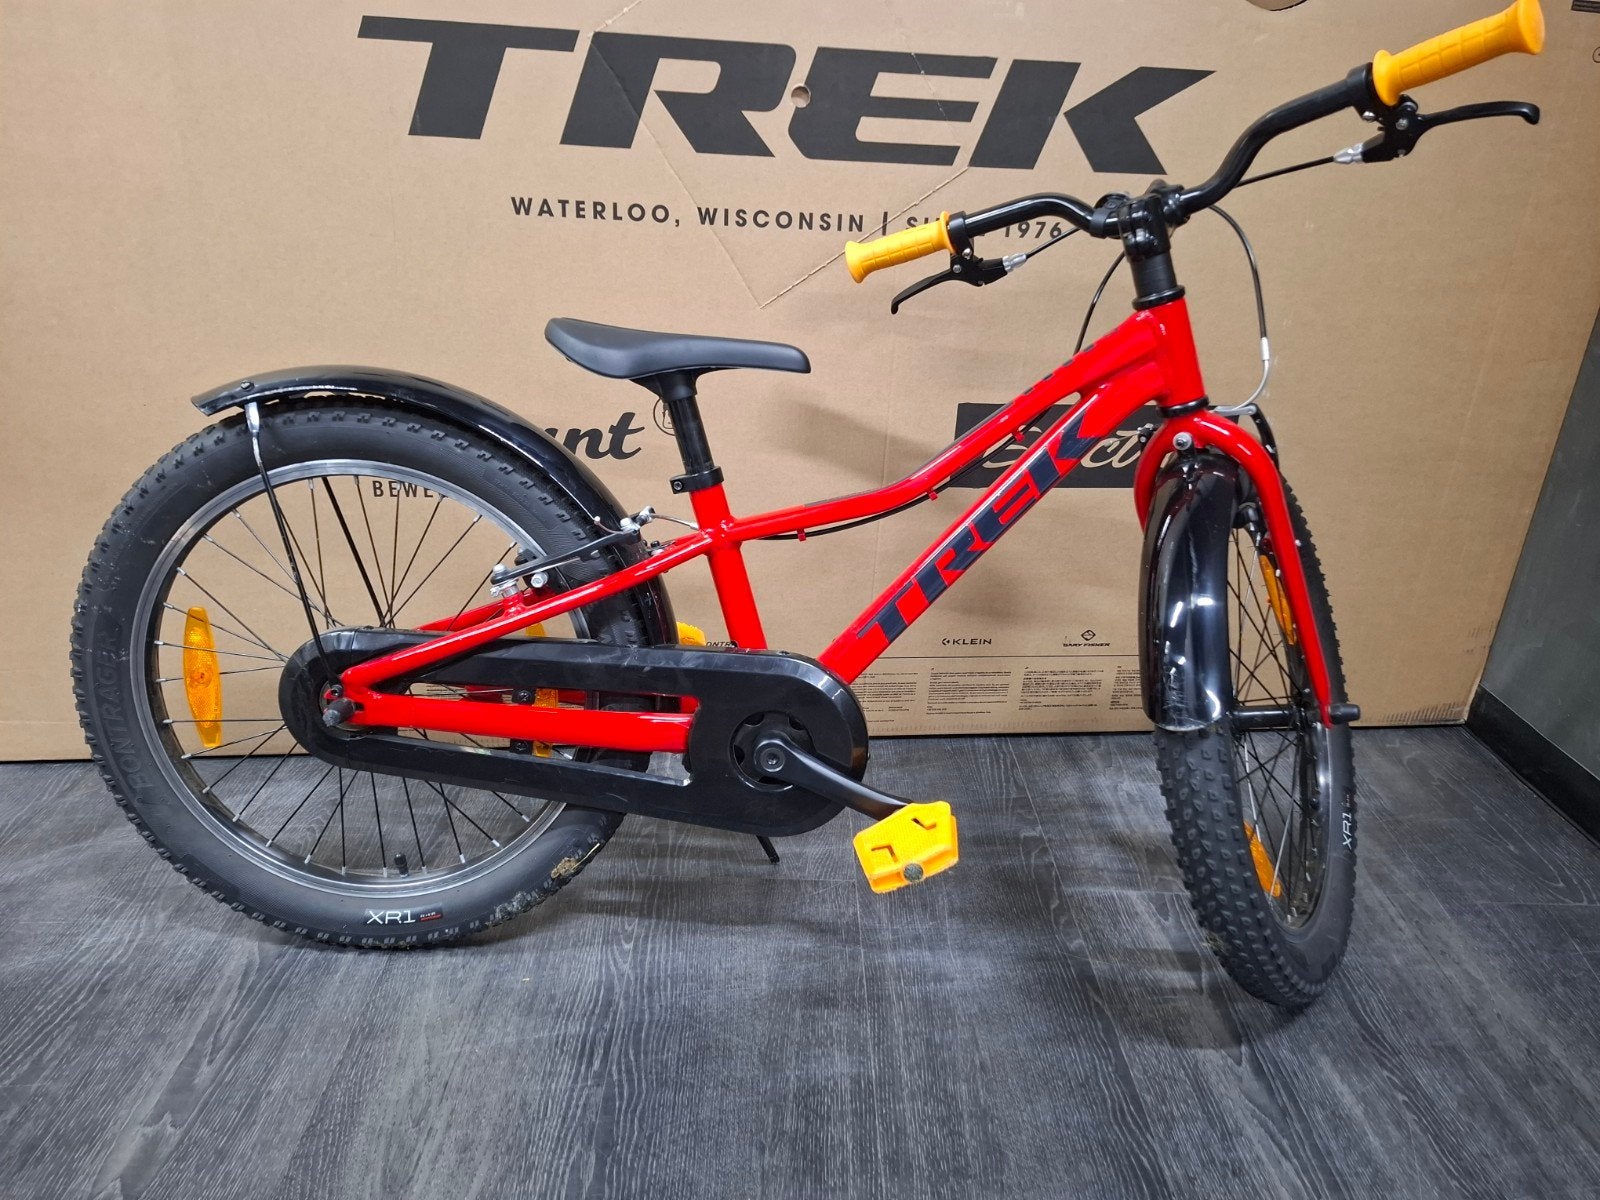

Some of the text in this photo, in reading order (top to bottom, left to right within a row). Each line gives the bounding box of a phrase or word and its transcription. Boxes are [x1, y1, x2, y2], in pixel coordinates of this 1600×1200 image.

[357, 15, 1217, 175] TREK
[511, 196, 681, 227] WATERLOO,
[697, 206, 865, 233] WISCONSIN
[1004, 221, 1062, 239] 1976
[856, 410, 1102, 643] TREK
[953, 637, 992, 646] KLEIN
[1342, 812, 1353, 850] XR1
[366, 909, 416, 925] XR1
